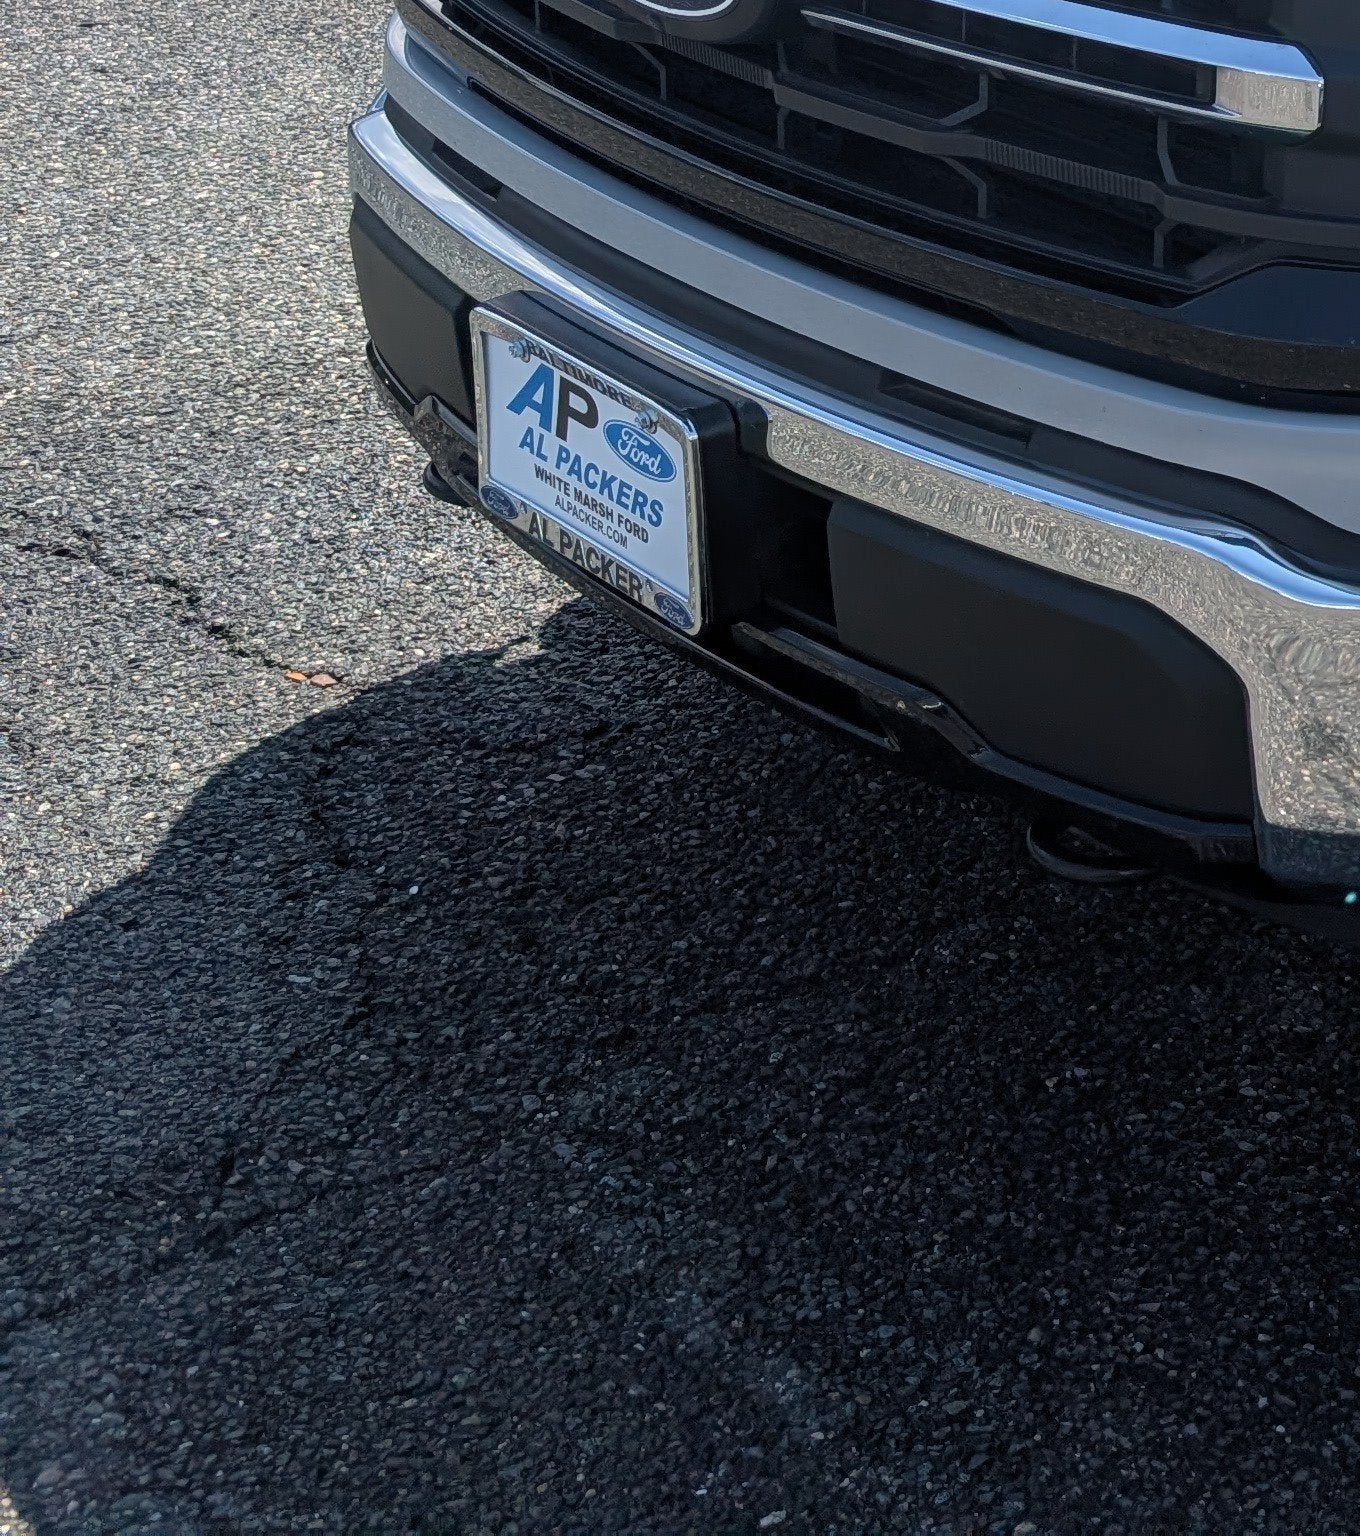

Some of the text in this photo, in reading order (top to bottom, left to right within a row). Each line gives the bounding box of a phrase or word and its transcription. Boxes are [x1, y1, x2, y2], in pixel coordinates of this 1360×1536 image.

[506, 363, 599, 443] AP
[518, 426, 664, 528] AL PACKERS
[617, 427, 663, 475] Ford
[534, 463, 649, 544] WHITE MARSH FORD
[554, 495, 628, 550] ALPACKER.COM
[528, 512, 644, 602] AL PACKER
